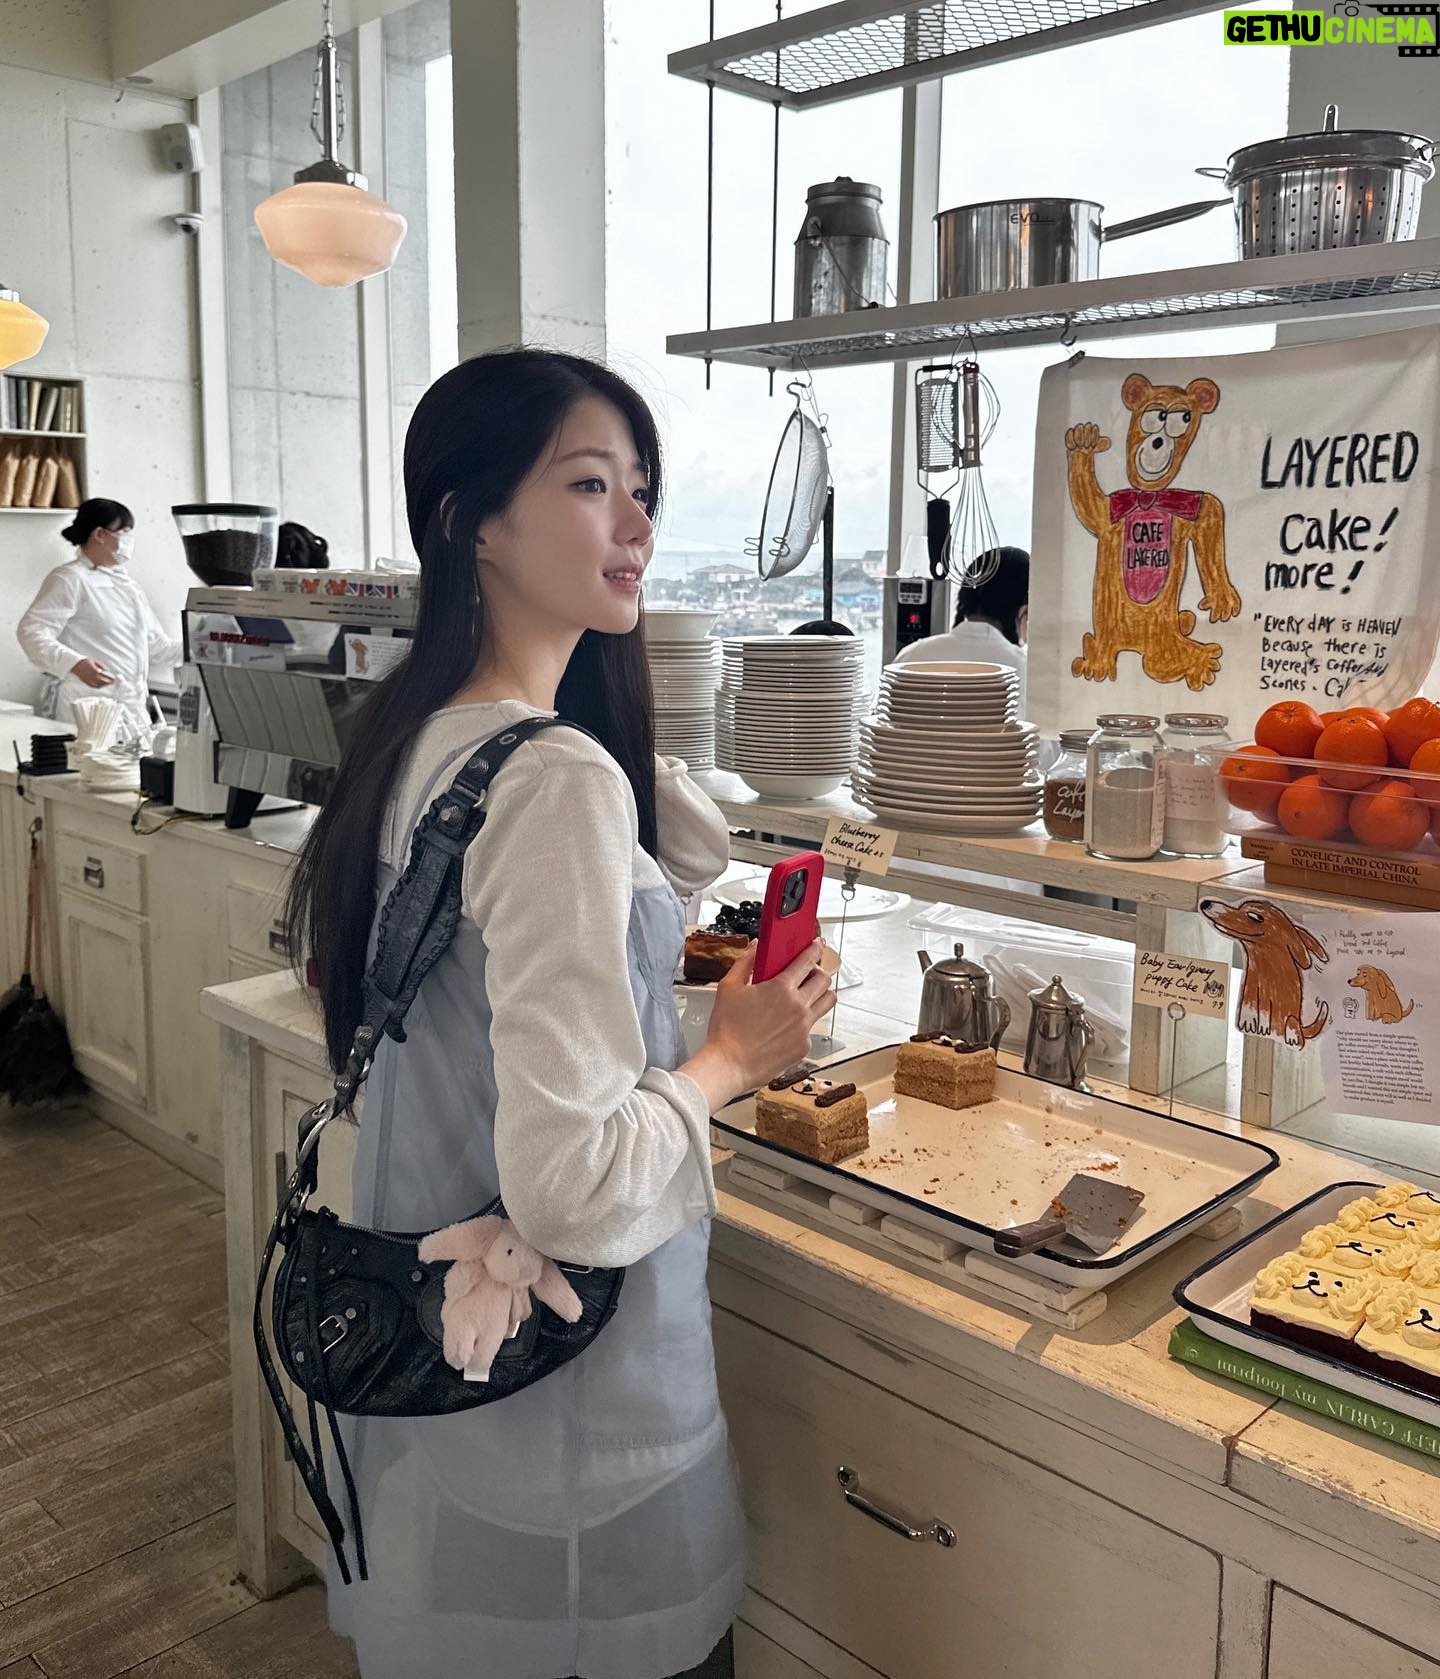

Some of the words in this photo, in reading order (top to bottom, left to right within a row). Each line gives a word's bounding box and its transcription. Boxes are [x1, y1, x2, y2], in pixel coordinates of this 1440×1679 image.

[1261, 431, 1419, 489] LAYERED
[1132, 522, 1165, 544] CAFE
[1280, 507, 1399, 555] Cake!
[1127, 547, 1170, 569] LAYERED
[1265, 560, 1364, 595] more!
[1342, 620, 1352, 632] is
[1357, 618, 1402, 637] HEAVEN
[1262, 637, 1313, 657] Because
[1324, 638, 1367, 655] there
[1374, 643, 1387, 659] is
[838, 822, 881, 845] Blueberry
[854, 842, 873, 856] Cake
[1291, 847, 1342, 863] CONFLICT
[1344, 856, 1368, 867] AND
[1369, 860, 1421, 876] CONTROL
[1292, 857, 1302, 866] IN
[1305, 859, 1330, 872] LATE
[1332, 863, 1380, 881] IMPERIAL
[1382, 872, 1418, 886] CHINA
[1140, 952, 1164, 973] Baby
[1175, 978, 1198, 992] Cake
[1216, 1359, 1286, 1400] footprint
[1292, 1384, 1317, 1405] my
[1326, 1398, 1396, 1435] GARLIN
